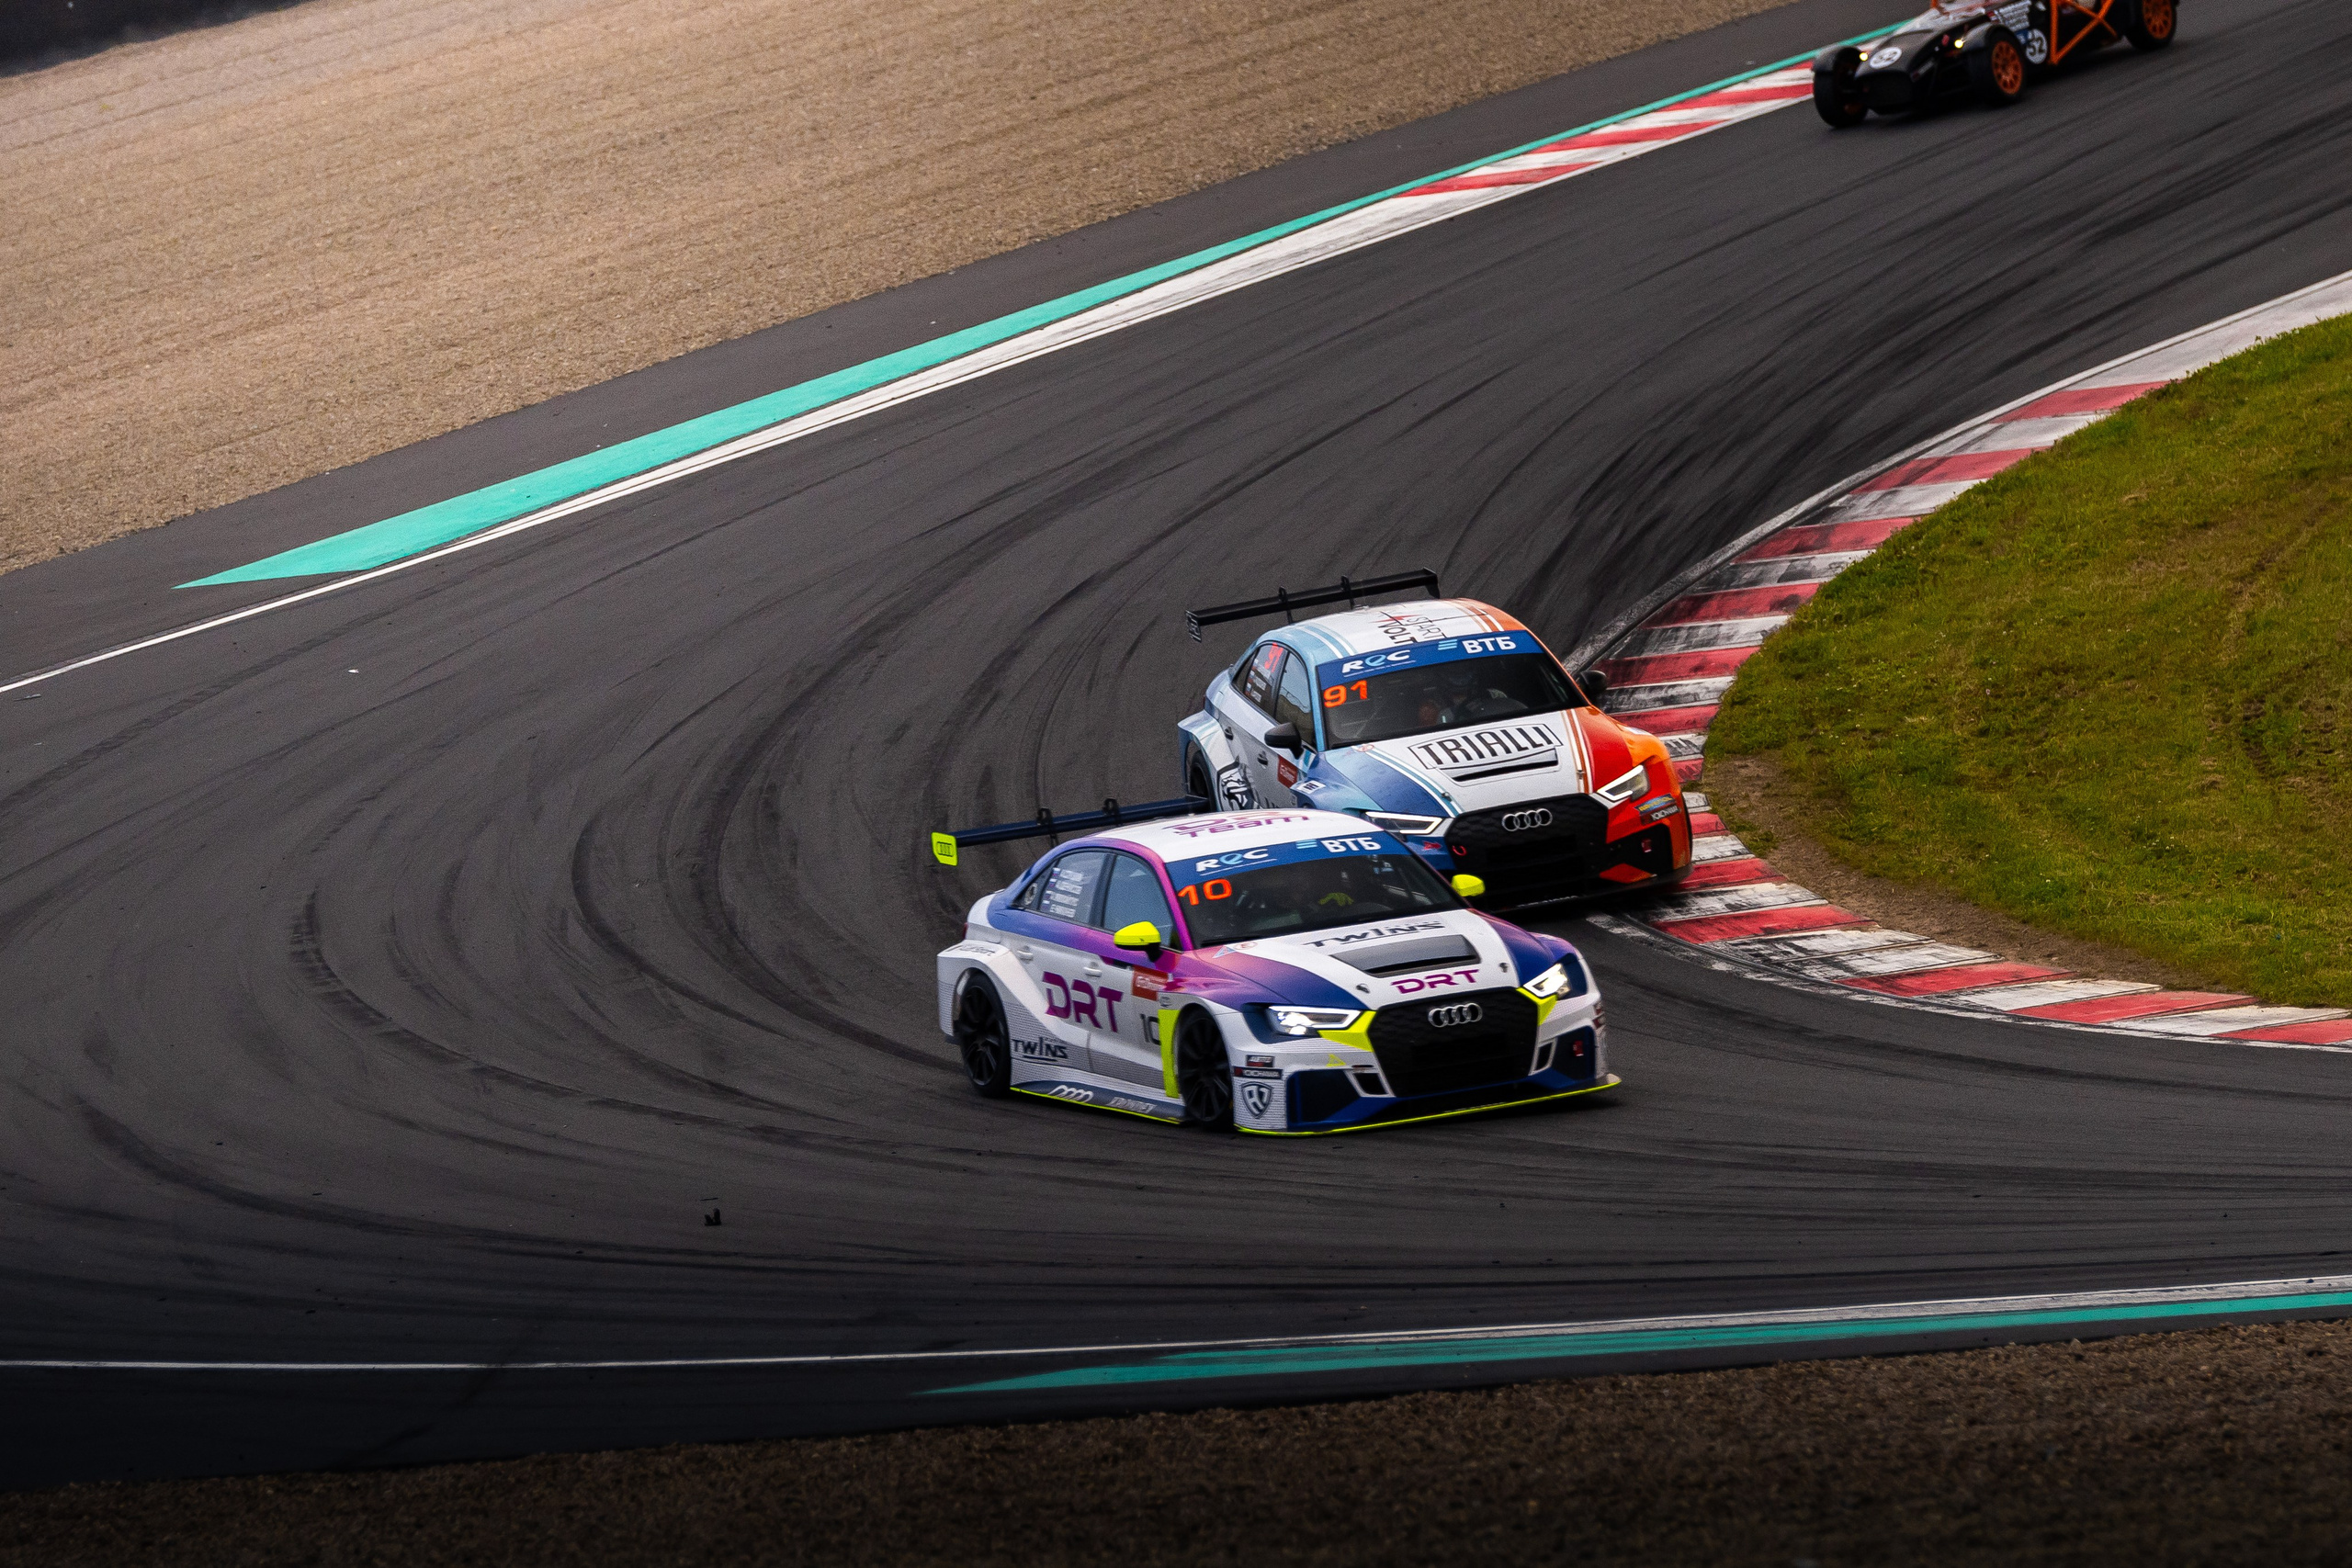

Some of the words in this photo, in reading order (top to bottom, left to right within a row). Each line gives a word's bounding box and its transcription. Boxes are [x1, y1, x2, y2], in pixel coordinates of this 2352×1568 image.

[1377, 621, 1419, 645] VOLT
[1407, 616, 1448, 638] START
[1462, 635, 1517, 654] ВТБ
[1323, 680, 1368, 708] 91
[1418, 727, 1554, 765] TRIALLI
[1320, 837, 1382, 853] ВТБ
[1177, 879, 1233, 906] 10
[1302, 921, 1446, 948] TWINS
[1391, 969, 1479, 994] DRT
[1042, 971, 1124, 1033] DRT
[1012, 1037, 1069, 1059] TWINS
